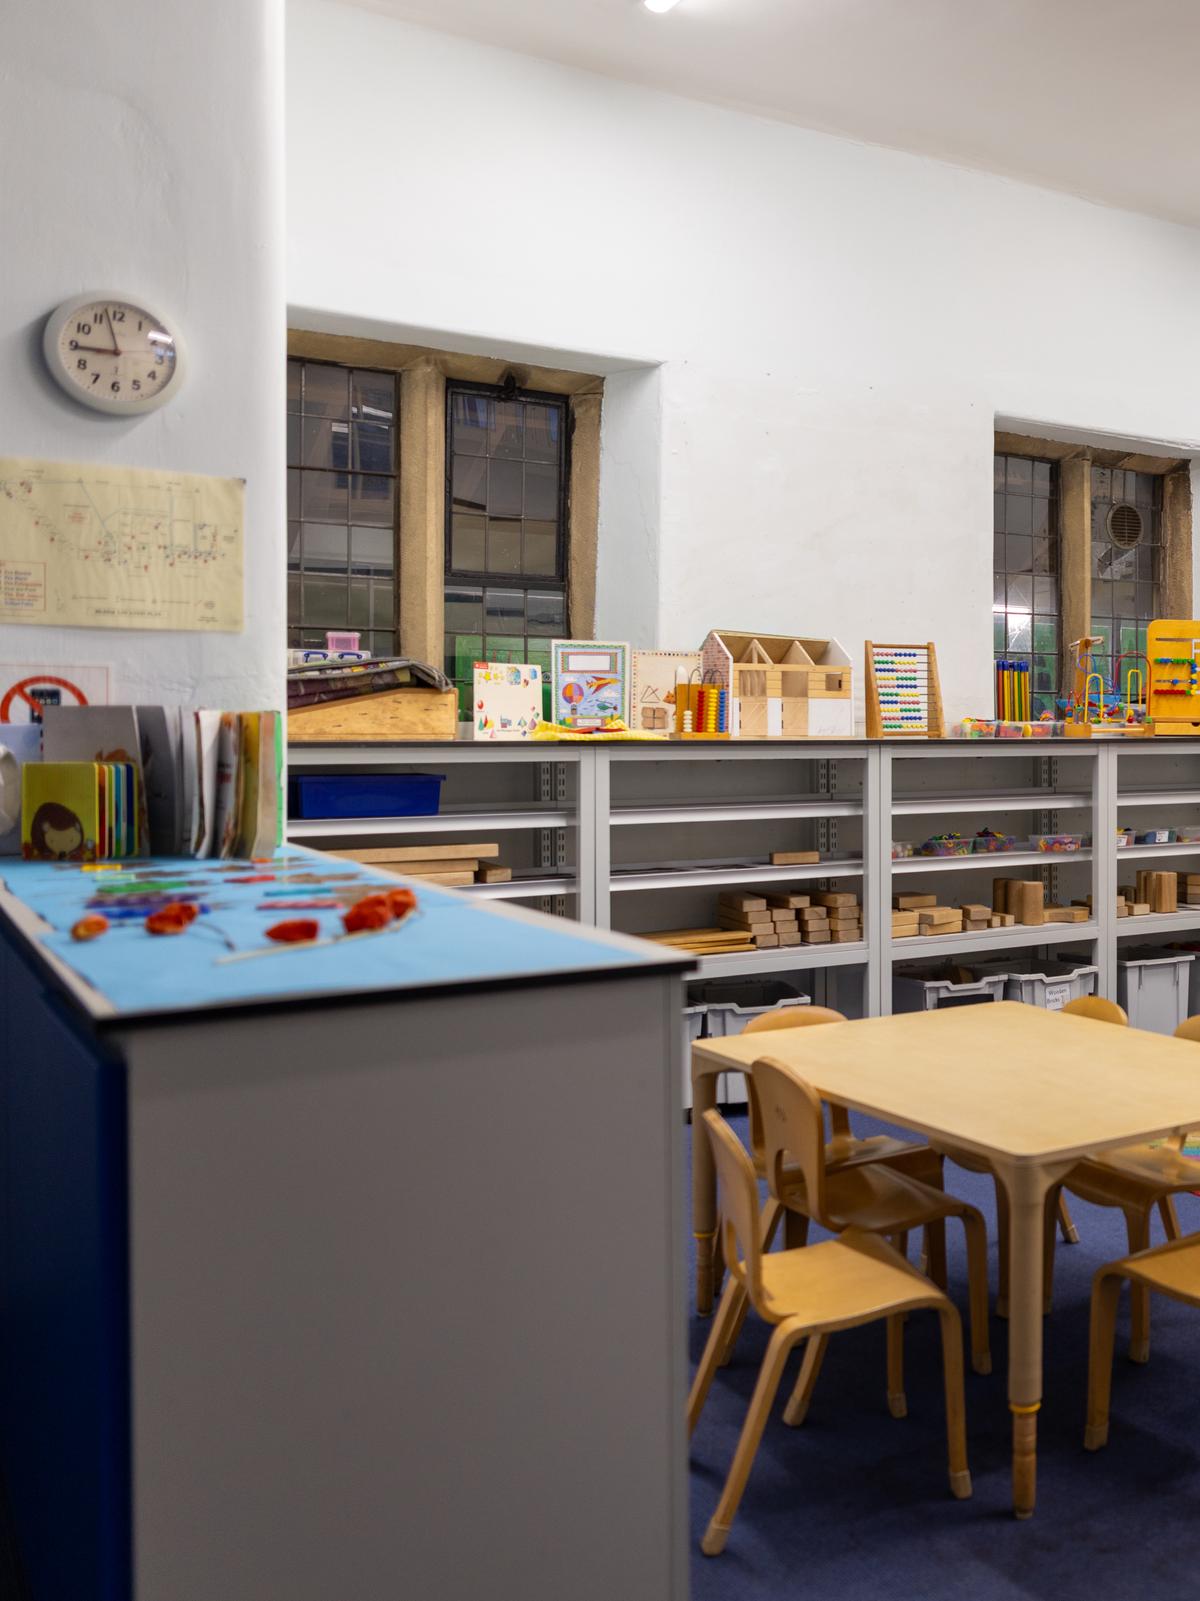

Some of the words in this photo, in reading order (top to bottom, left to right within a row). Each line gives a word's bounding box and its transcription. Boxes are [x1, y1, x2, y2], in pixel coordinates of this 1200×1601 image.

[93, 313, 103, 324] 11
[112, 310, 125, 322] 12
[76, 322, 91, 335] 10
[69, 340, 79, 351] 9
[77, 359, 87, 370] 8
[91, 373, 101, 384] 7
[147, 371, 157, 381] 4
[111, 381, 120, 392] 6
[132, 380, 141, 391] 5
